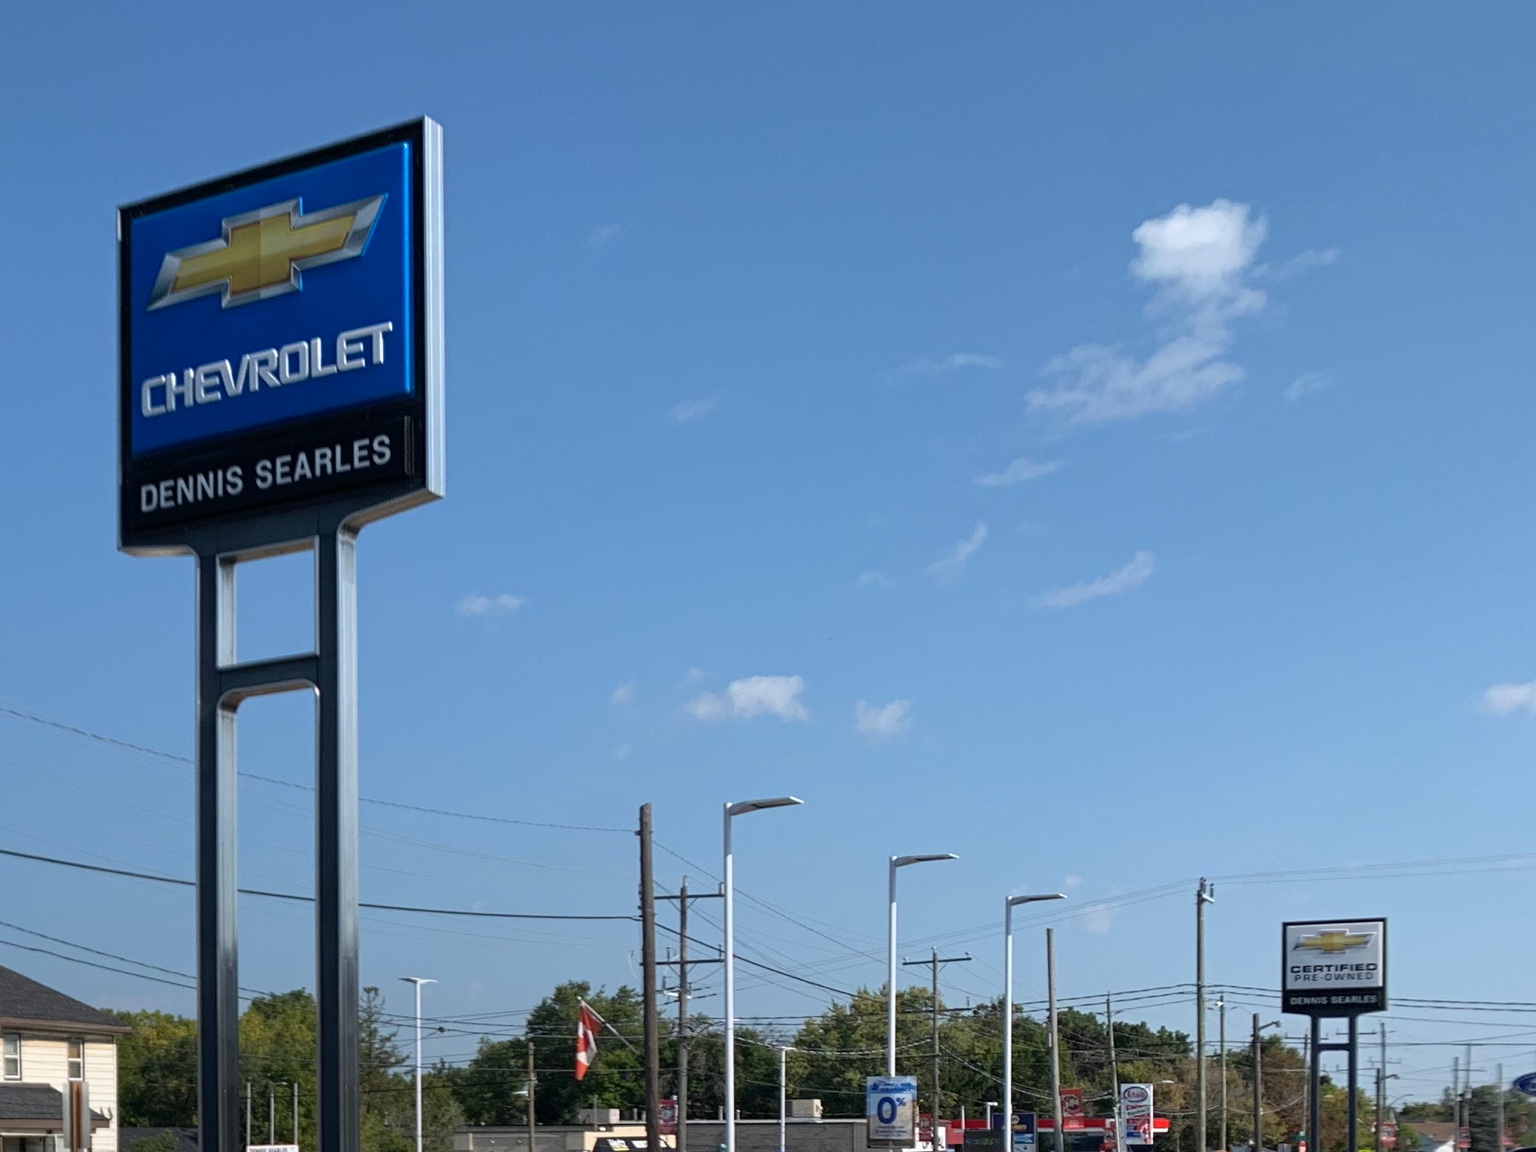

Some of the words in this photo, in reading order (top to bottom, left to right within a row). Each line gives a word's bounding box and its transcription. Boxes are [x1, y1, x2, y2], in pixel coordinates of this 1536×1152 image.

[141, 321, 393, 418] CHEVROLET
[140, 465, 243, 513] DENNIS
[255, 434, 392, 490] SEARLES
[1290, 963, 1378, 974] CERTIFIED
[1294, 972, 1374, 982] PRE-OWNED
[1290, 996, 1328, 1006] DENNIS
[1330, 995, 1378, 1004] SEARLES
